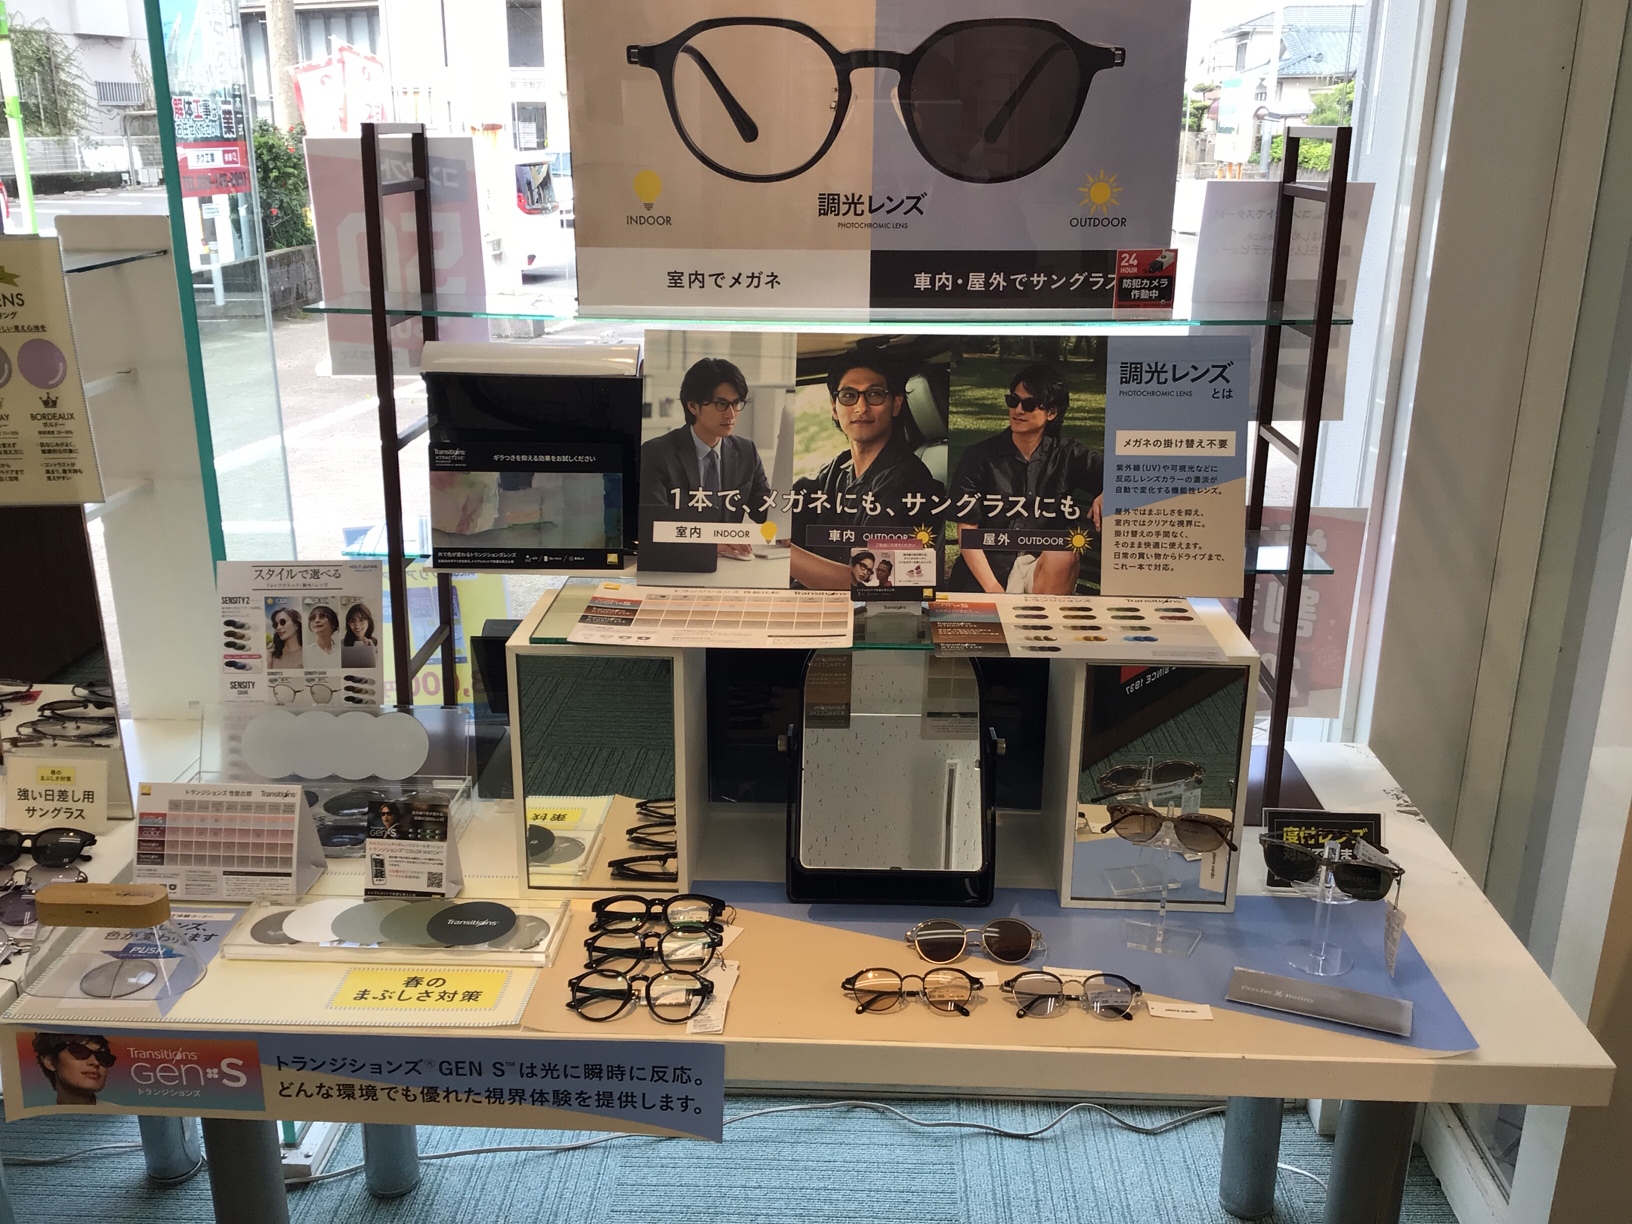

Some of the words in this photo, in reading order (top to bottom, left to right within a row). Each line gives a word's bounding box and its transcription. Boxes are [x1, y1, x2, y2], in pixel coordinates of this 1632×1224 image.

[817, 192, 928, 217] 調光レンズ
[626, 215, 672, 226] INDOOR
[837, 222, 891, 230] PHOTOCHROMIC
[1069, 217, 1127, 228] OUTDOOR
[1121, 253, 1139, 266] 24
[667, 270, 782, 290] 室内でメガネ
[1122, 278, 1169, 289] 防犯カメラ
[1131, 289, 1159, 300] 作動中
[1120, 361, 1235, 385] 調光レンズ
[1211, 387, 1234, 399] とは
[30, 412, 75, 421] BORDEAUX
[1123, 438, 1228, 449] メガネの掛け替え不要
[1115, 475, 1218, 484] 反応しレンズカラーの濃淡が
[1115, 486, 1222, 495] 自動で変化する機能性レンズ。
[670, 486, 1081, 520] 1本で、メガネにも、サングラスにも
[1114, 508, 1204, 517] 屋外ではまぶしさを抑え、
[1114, 519, 1206, 528] 室内ではクリアな視界に。
[675, 526, 701, 539] 室内
[713, 529, 750, 539] INDOOR
[828, 529, 856, 542] 車内
[1114, 530, 1189, 538] 掛け替えの手間なく、
[982, 533, 1011, 547] 屋外
[1017, 536, 1064, 546] OUTDOOR
[1113, 541, 1203, 550] そのまま快適に使えます。
[1113, 563, 1174, 571] これ一本で対応。
[253, 567, 341, 581] スタイルで選べる
[221, 597, 245, 605] SENSITY
[230, 681, 256, 690] SENSITY
[17, 788, 95, 803] 強い日差し用
[261, 790, 296, 800] Transitions
[25, 806, 86, 820] サングラス
[447, 918, 500, 929] Transitions
[129, 947, 166, 955] PUSH
[403, 976, 446, 988] 春の
[353, 989, 483, 1002] まぶしさ対策
[127, 1047, 198, 1063] Transitions
[438, 1060, 483, 1077] GEN
[138, 1088, 201, 1097] トランジションズ
[278, 1081, 703, 1115] どんな環境でも優れた視界体験を提供します。
